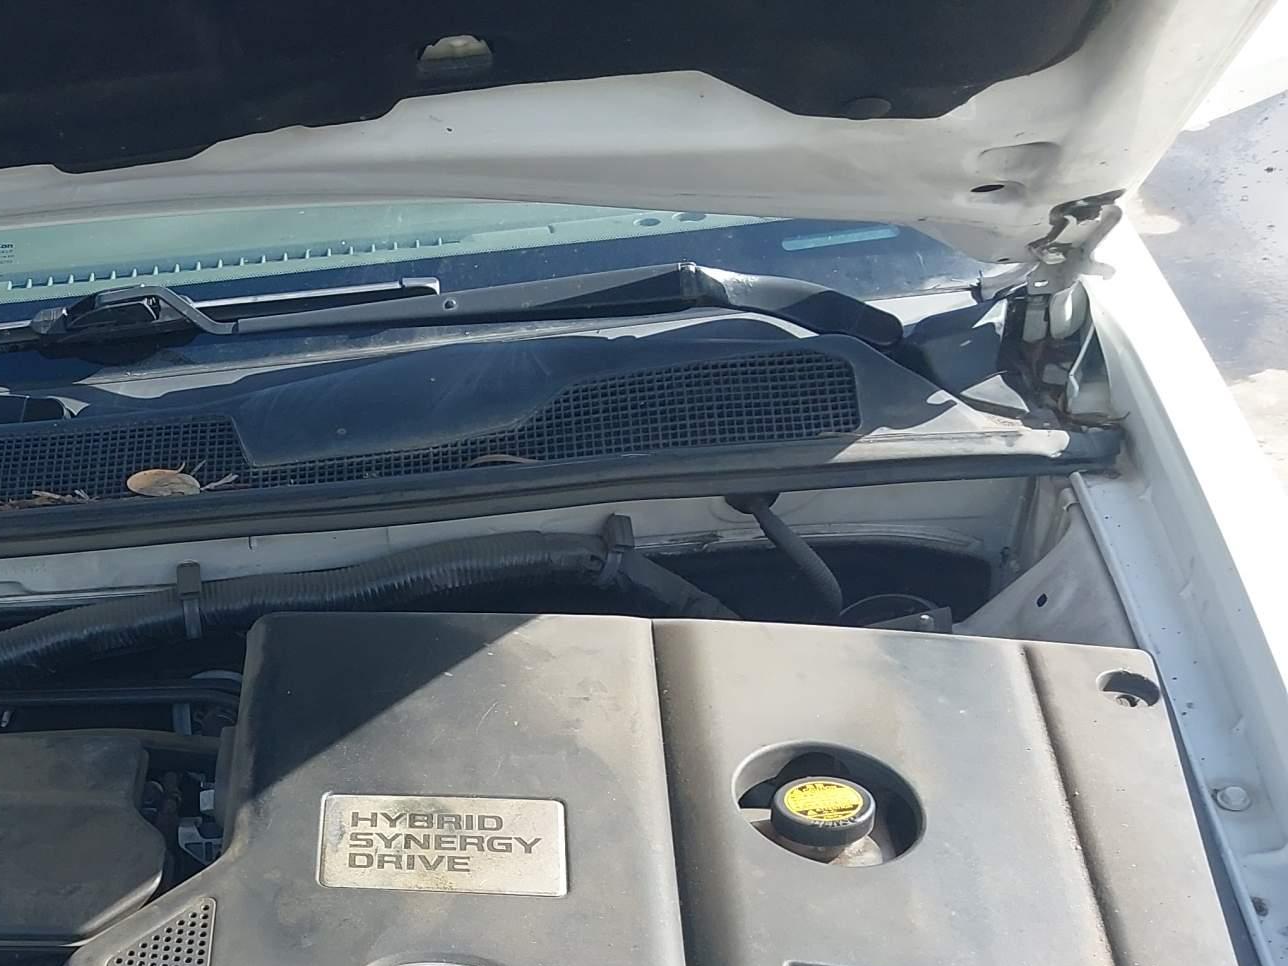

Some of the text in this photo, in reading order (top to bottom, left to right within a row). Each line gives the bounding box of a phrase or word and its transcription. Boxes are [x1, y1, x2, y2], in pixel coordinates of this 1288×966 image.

[351, 811, 504, 831] HYBRID
[349, 832, 542, 854] SYNERGY
[348, 852, 471, 872] DRIVE
